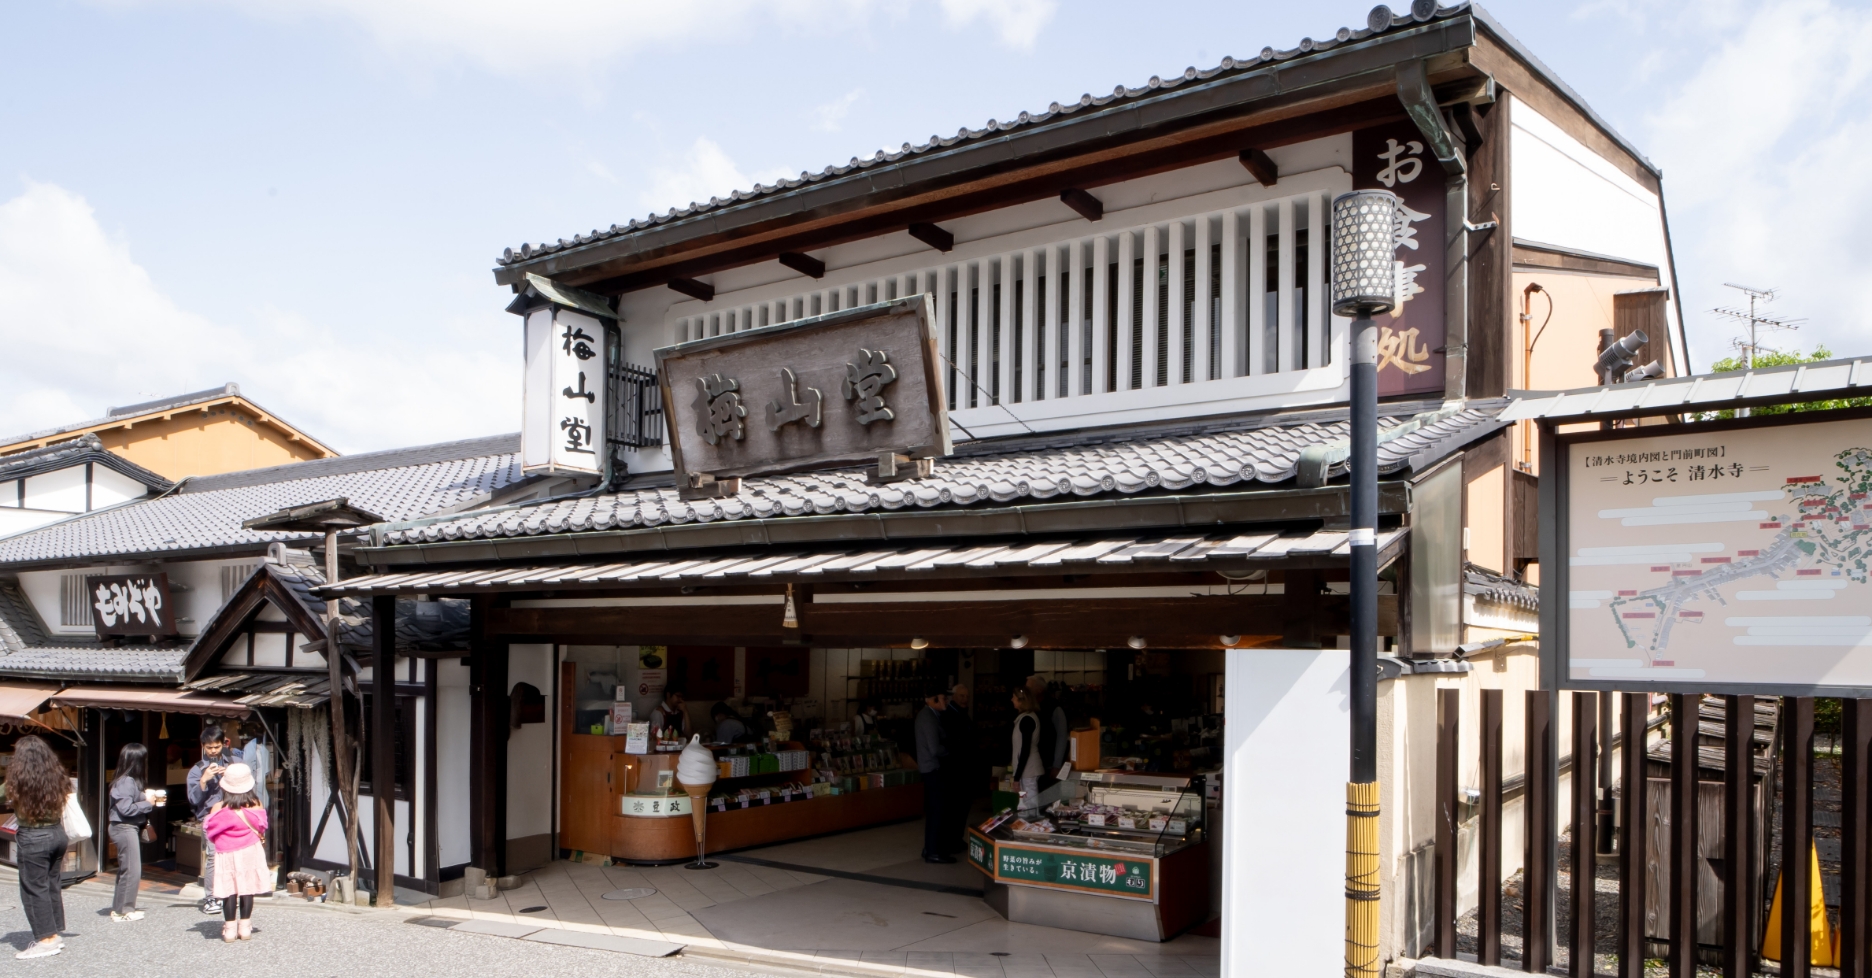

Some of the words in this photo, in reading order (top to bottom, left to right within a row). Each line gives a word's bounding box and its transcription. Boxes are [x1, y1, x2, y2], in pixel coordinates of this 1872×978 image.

[560, 325, 596, 454] 梅山堂
[690, 347, 898, 446] 梅山堂
[1585, 445, 1726, 468] 【清水寺境内図と門前町図】
[1622, 467, 1679, 486] ようこそ
[1689, 462, 1744, 482] 清水寺
[652, 800, 681, 813] 豆政
[1002, 854, 1043, 866] 野菜の旨みが
[1002, 863, 1039, 875] 生きている。
[1059, 859, 1117, 885] 京漬物
